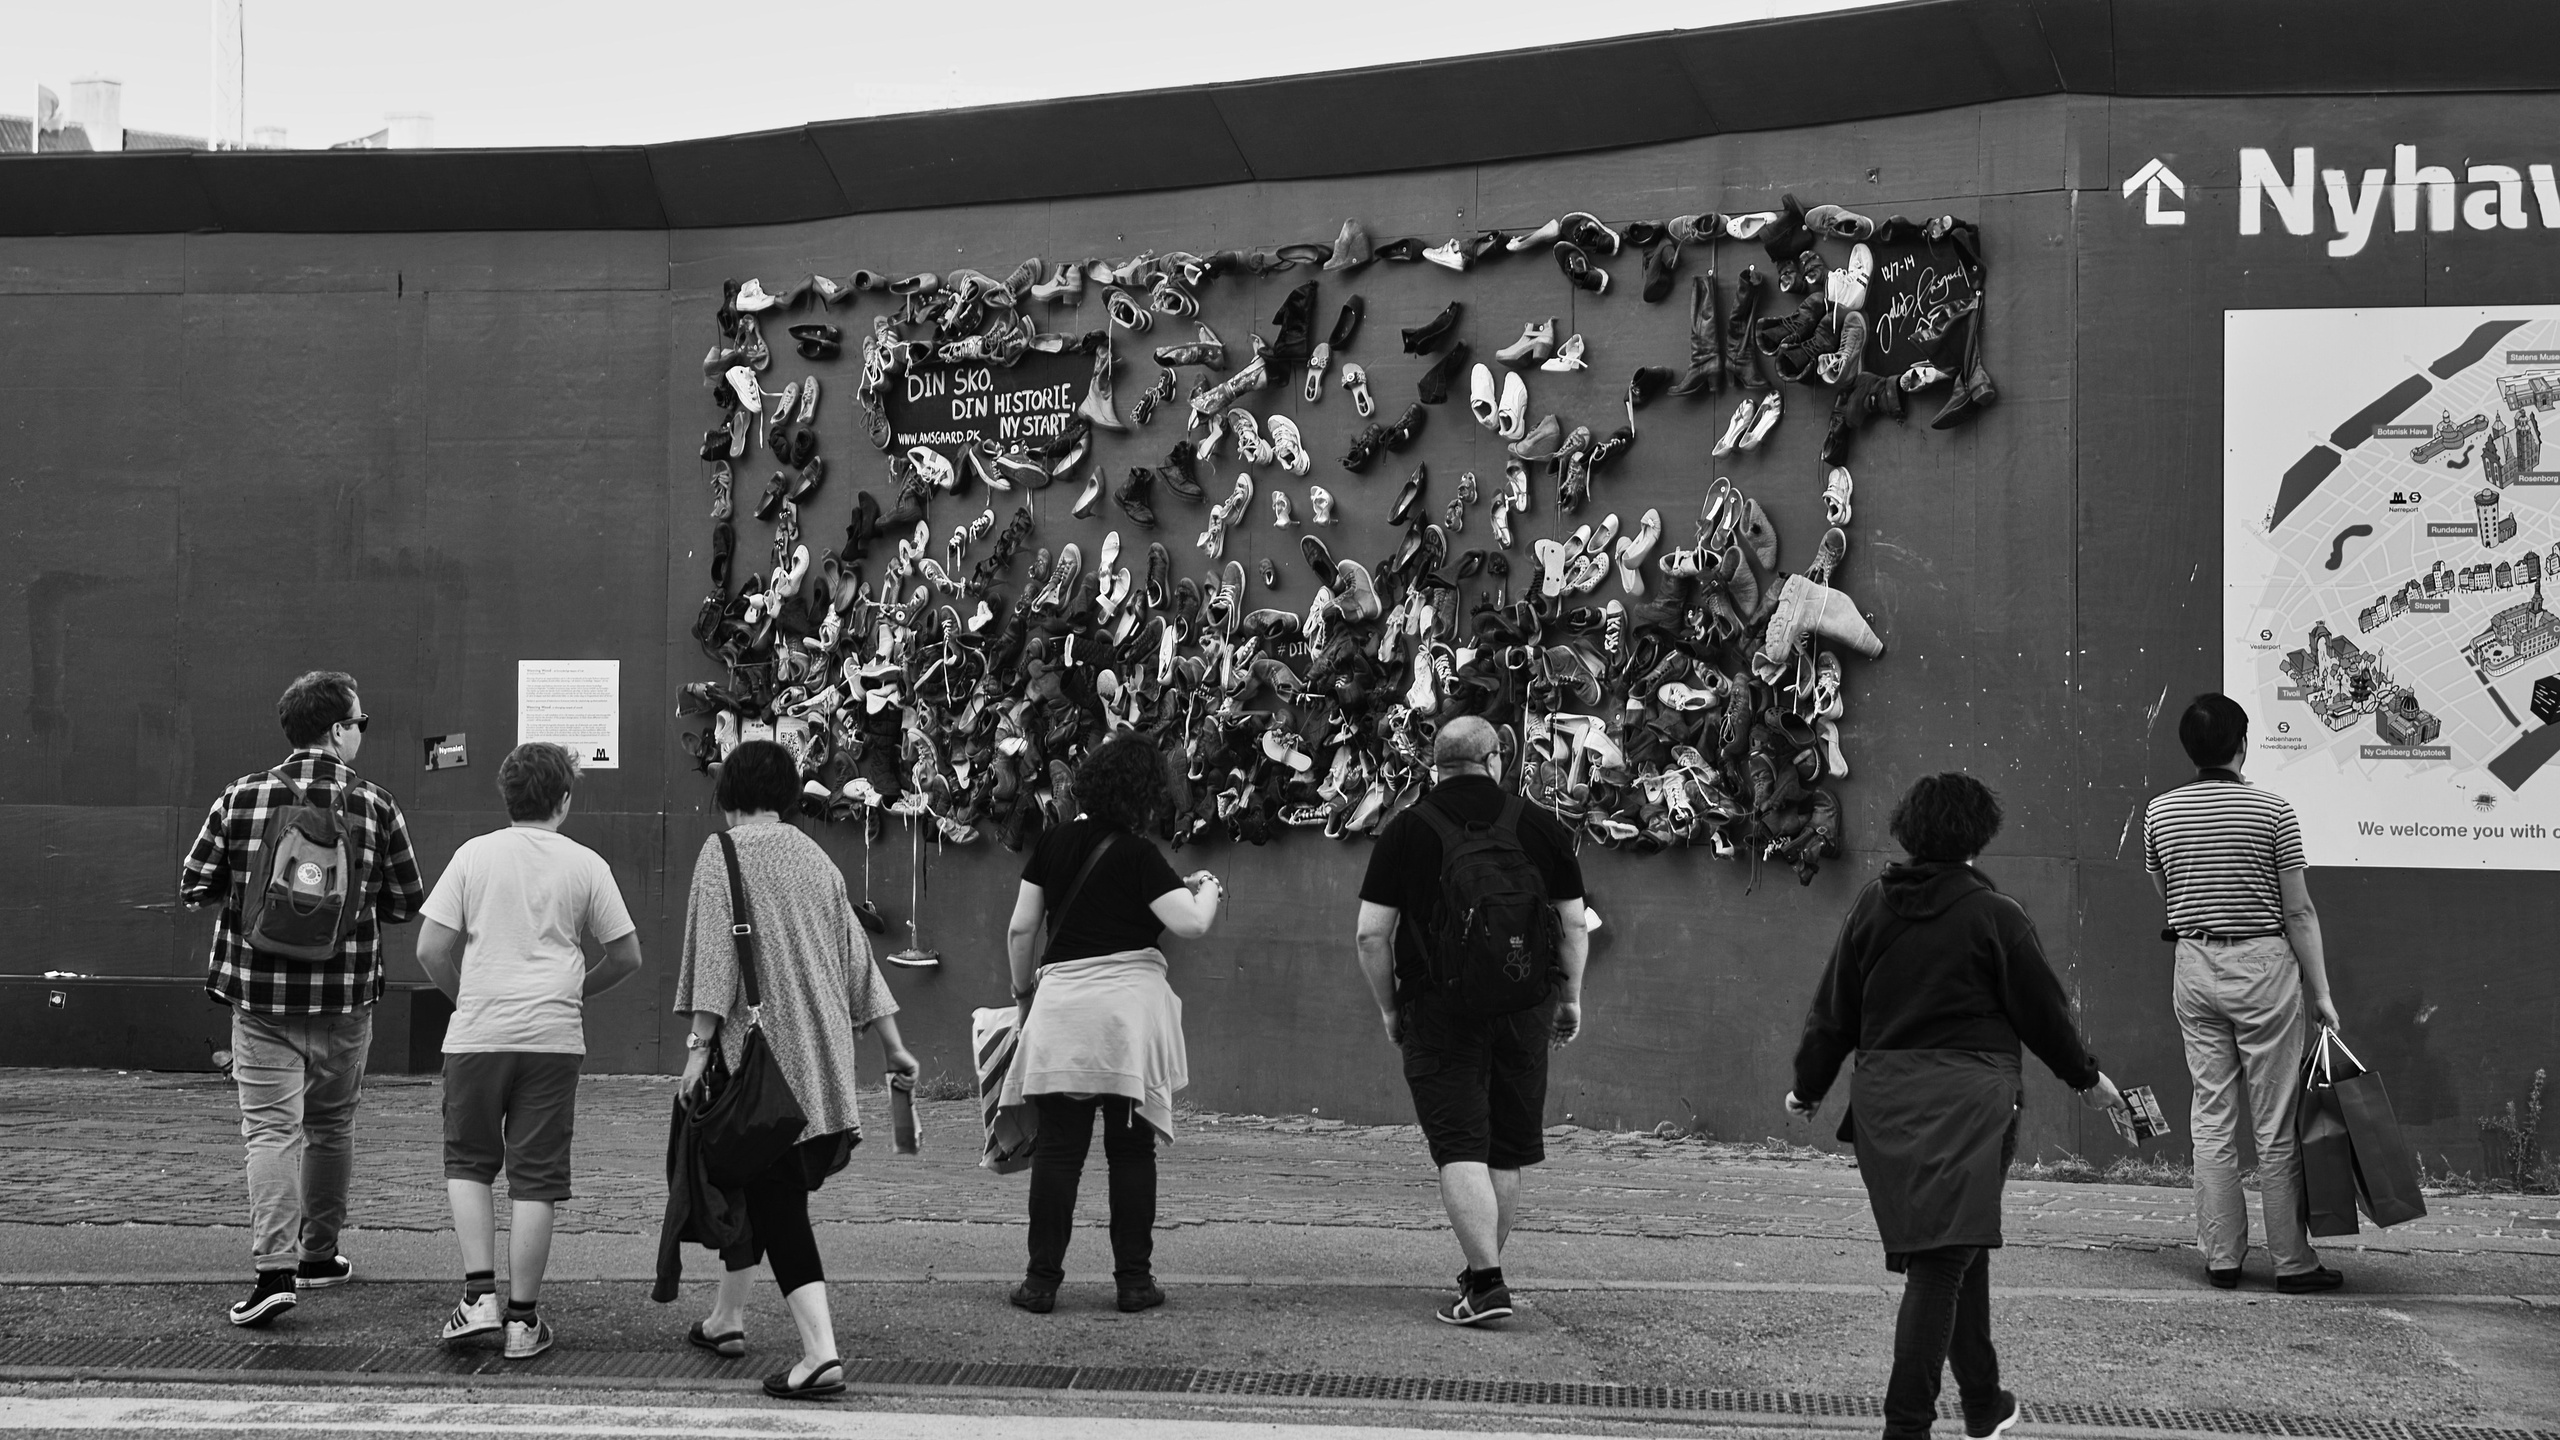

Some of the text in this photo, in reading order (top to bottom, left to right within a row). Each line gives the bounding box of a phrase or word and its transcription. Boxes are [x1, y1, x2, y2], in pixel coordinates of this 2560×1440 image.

[2510, 353, 2538, 361] Statens
[908, 368, 994, 402] DIN SKO,
[952, 383, 1076, 420] DIN HISTORIE,
[1000, 412, 1070, 440] NY START
[2377, 428, 2428, 436] Botanisk Have
[898, 430, 982, 445] WWW.AMSGAARD.DK
[2518, 475, 2558, 483] Rosenborg
[2364, 748, 2446, 758] Ny Carlsberg Glyptotek
[2358, 821, 2384, 836] We
[2390, 822, 2468, 837] welcome
[2472, 826, 2504, 840] you
[2510, 824, 2546, 838] with
